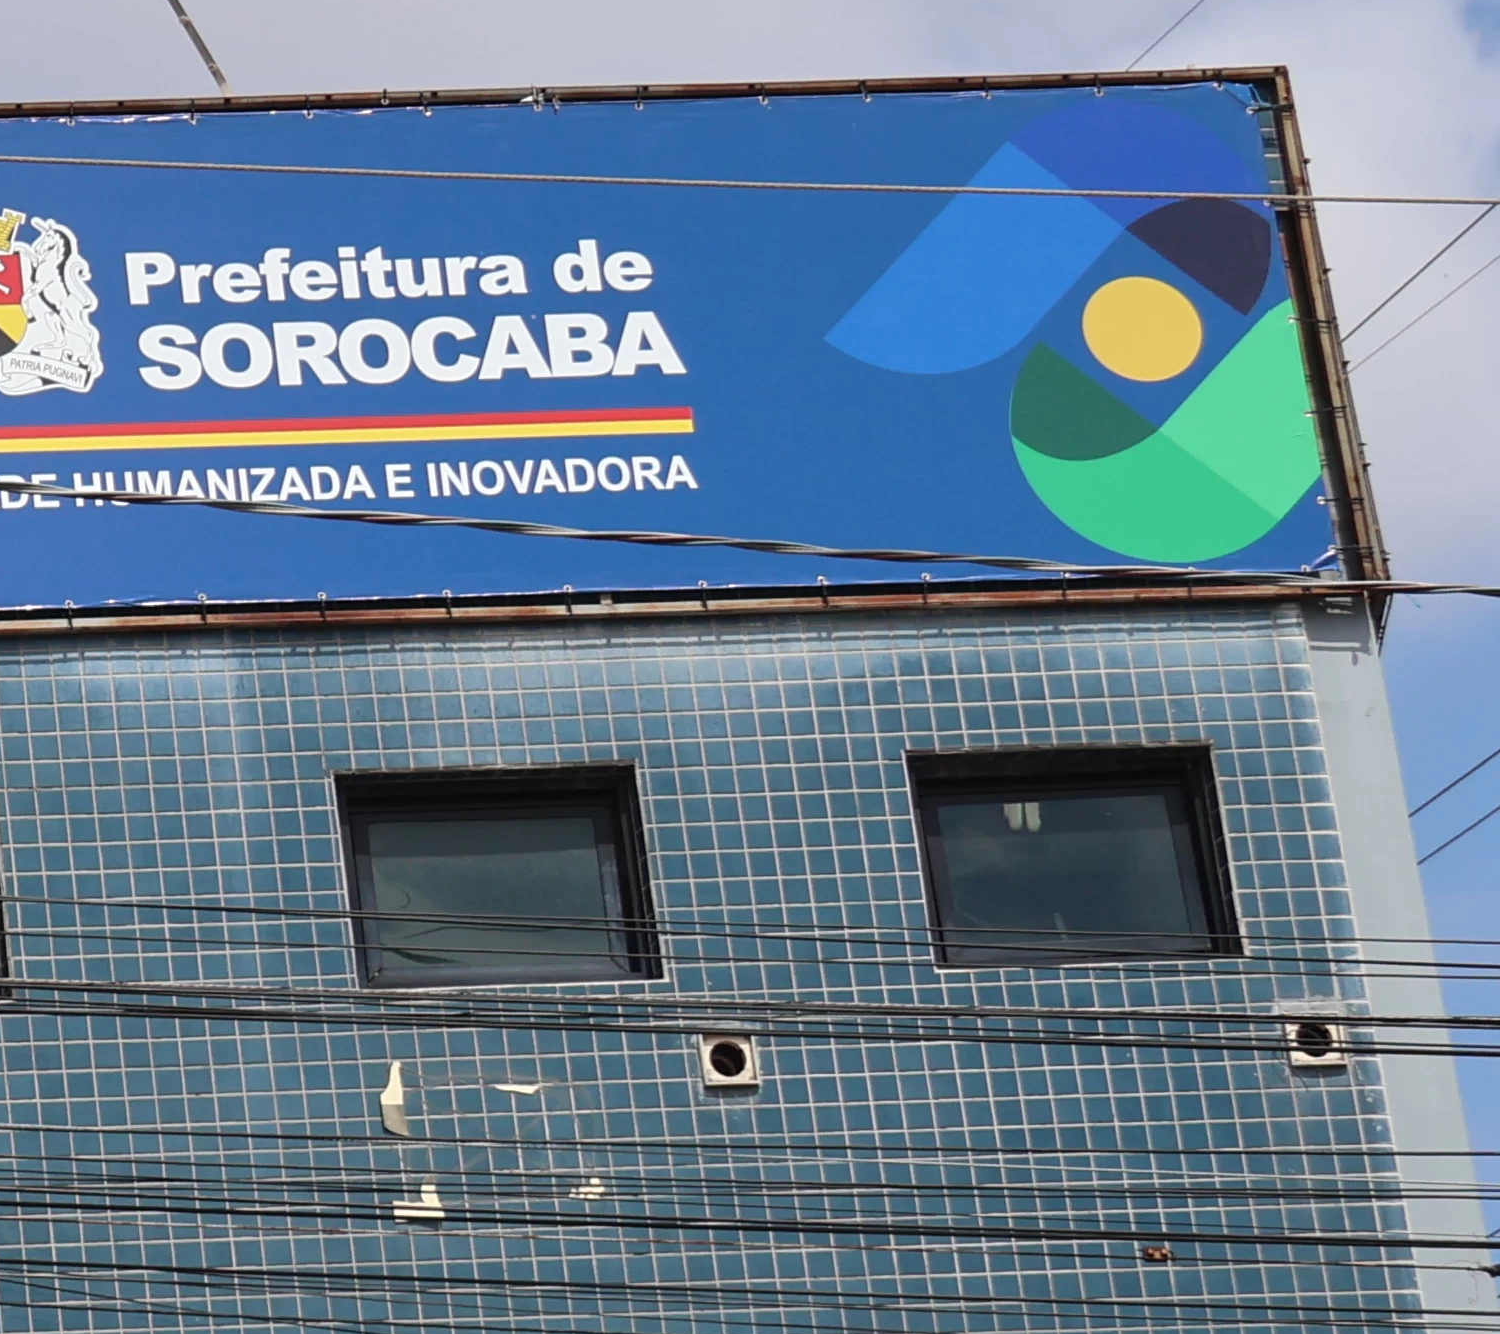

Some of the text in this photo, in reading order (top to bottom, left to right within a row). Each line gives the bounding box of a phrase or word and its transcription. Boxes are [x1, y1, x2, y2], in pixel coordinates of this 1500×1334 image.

[124, 239, 653, 305] Prefeitura de
[9, 358, 83, 384] PATRIA PUGNAVI
[138, 311, 688, 391] SOROCABA
[73, 464, 376, 508] HUMANIZADA
[384, 463, 415, 499] E
[426, 455, 699, 497] INOVADORA
